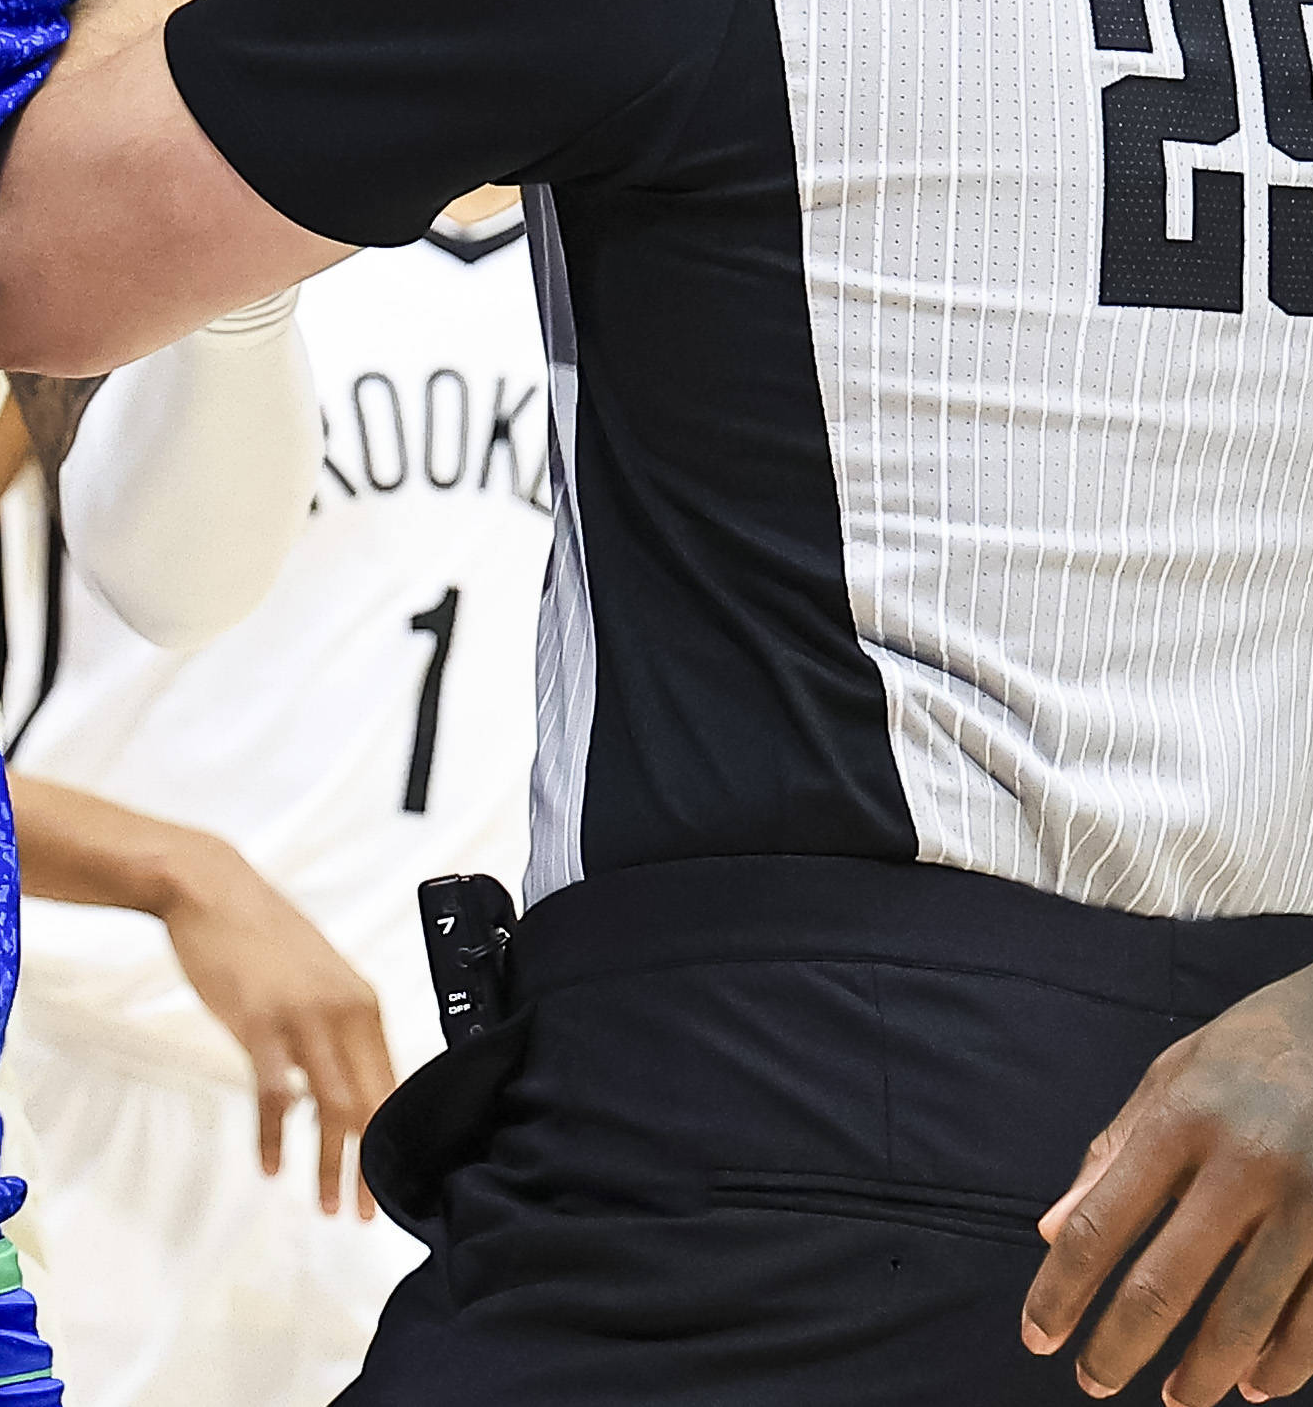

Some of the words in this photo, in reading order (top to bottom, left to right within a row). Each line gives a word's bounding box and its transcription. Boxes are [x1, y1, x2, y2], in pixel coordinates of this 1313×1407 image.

[397, 587, 461, 815] 1
[448, 990, 468, 1003] ON
[448, 1003, 472, 1016] OFF
